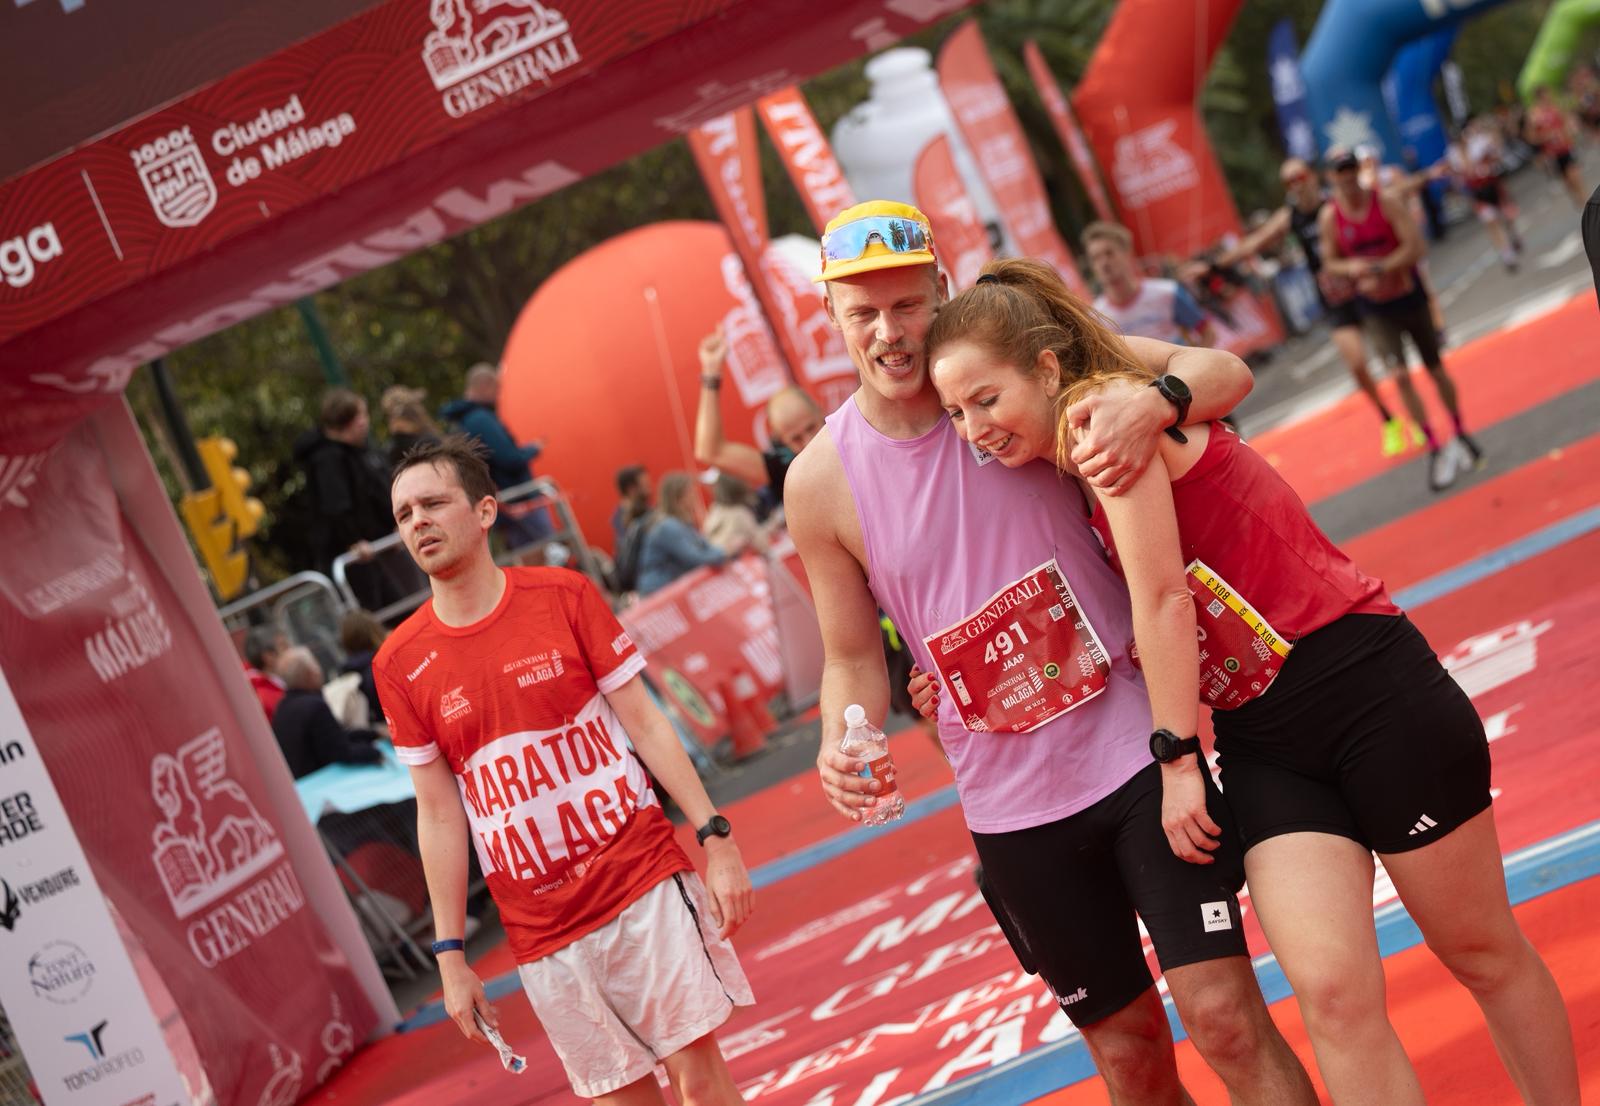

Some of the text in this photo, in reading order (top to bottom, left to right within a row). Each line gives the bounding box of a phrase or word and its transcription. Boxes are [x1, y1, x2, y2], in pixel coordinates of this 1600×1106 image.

[442, 32, 582, 118] GENERALI
[212, 94, 305, 156] Ciudad
[226, 113, 357, 187] de Málaga
[0, 222, 63, 288] ga
[965, 576, 1045, 639] GENERALI
[1060, 590, 1074, 609] BOX
[1206, 577, 1230, 600] BOX 3
[984, 621, 1029, 665] 491
[1085, 639, 1105, 665] BOX 2
[1254, 622, 1277, 646] BOX 3
[516, 667, 556, 689] MÁLAGA
[1002, 653, 1025, 672] JAAP
[1001, 685, 1035, 710] MÁLAGA
[480, 774, 639, 881] MÁLAGA
[186, 866, 304, 968] GENERALI
[31, 960, 96, 998] Natura
